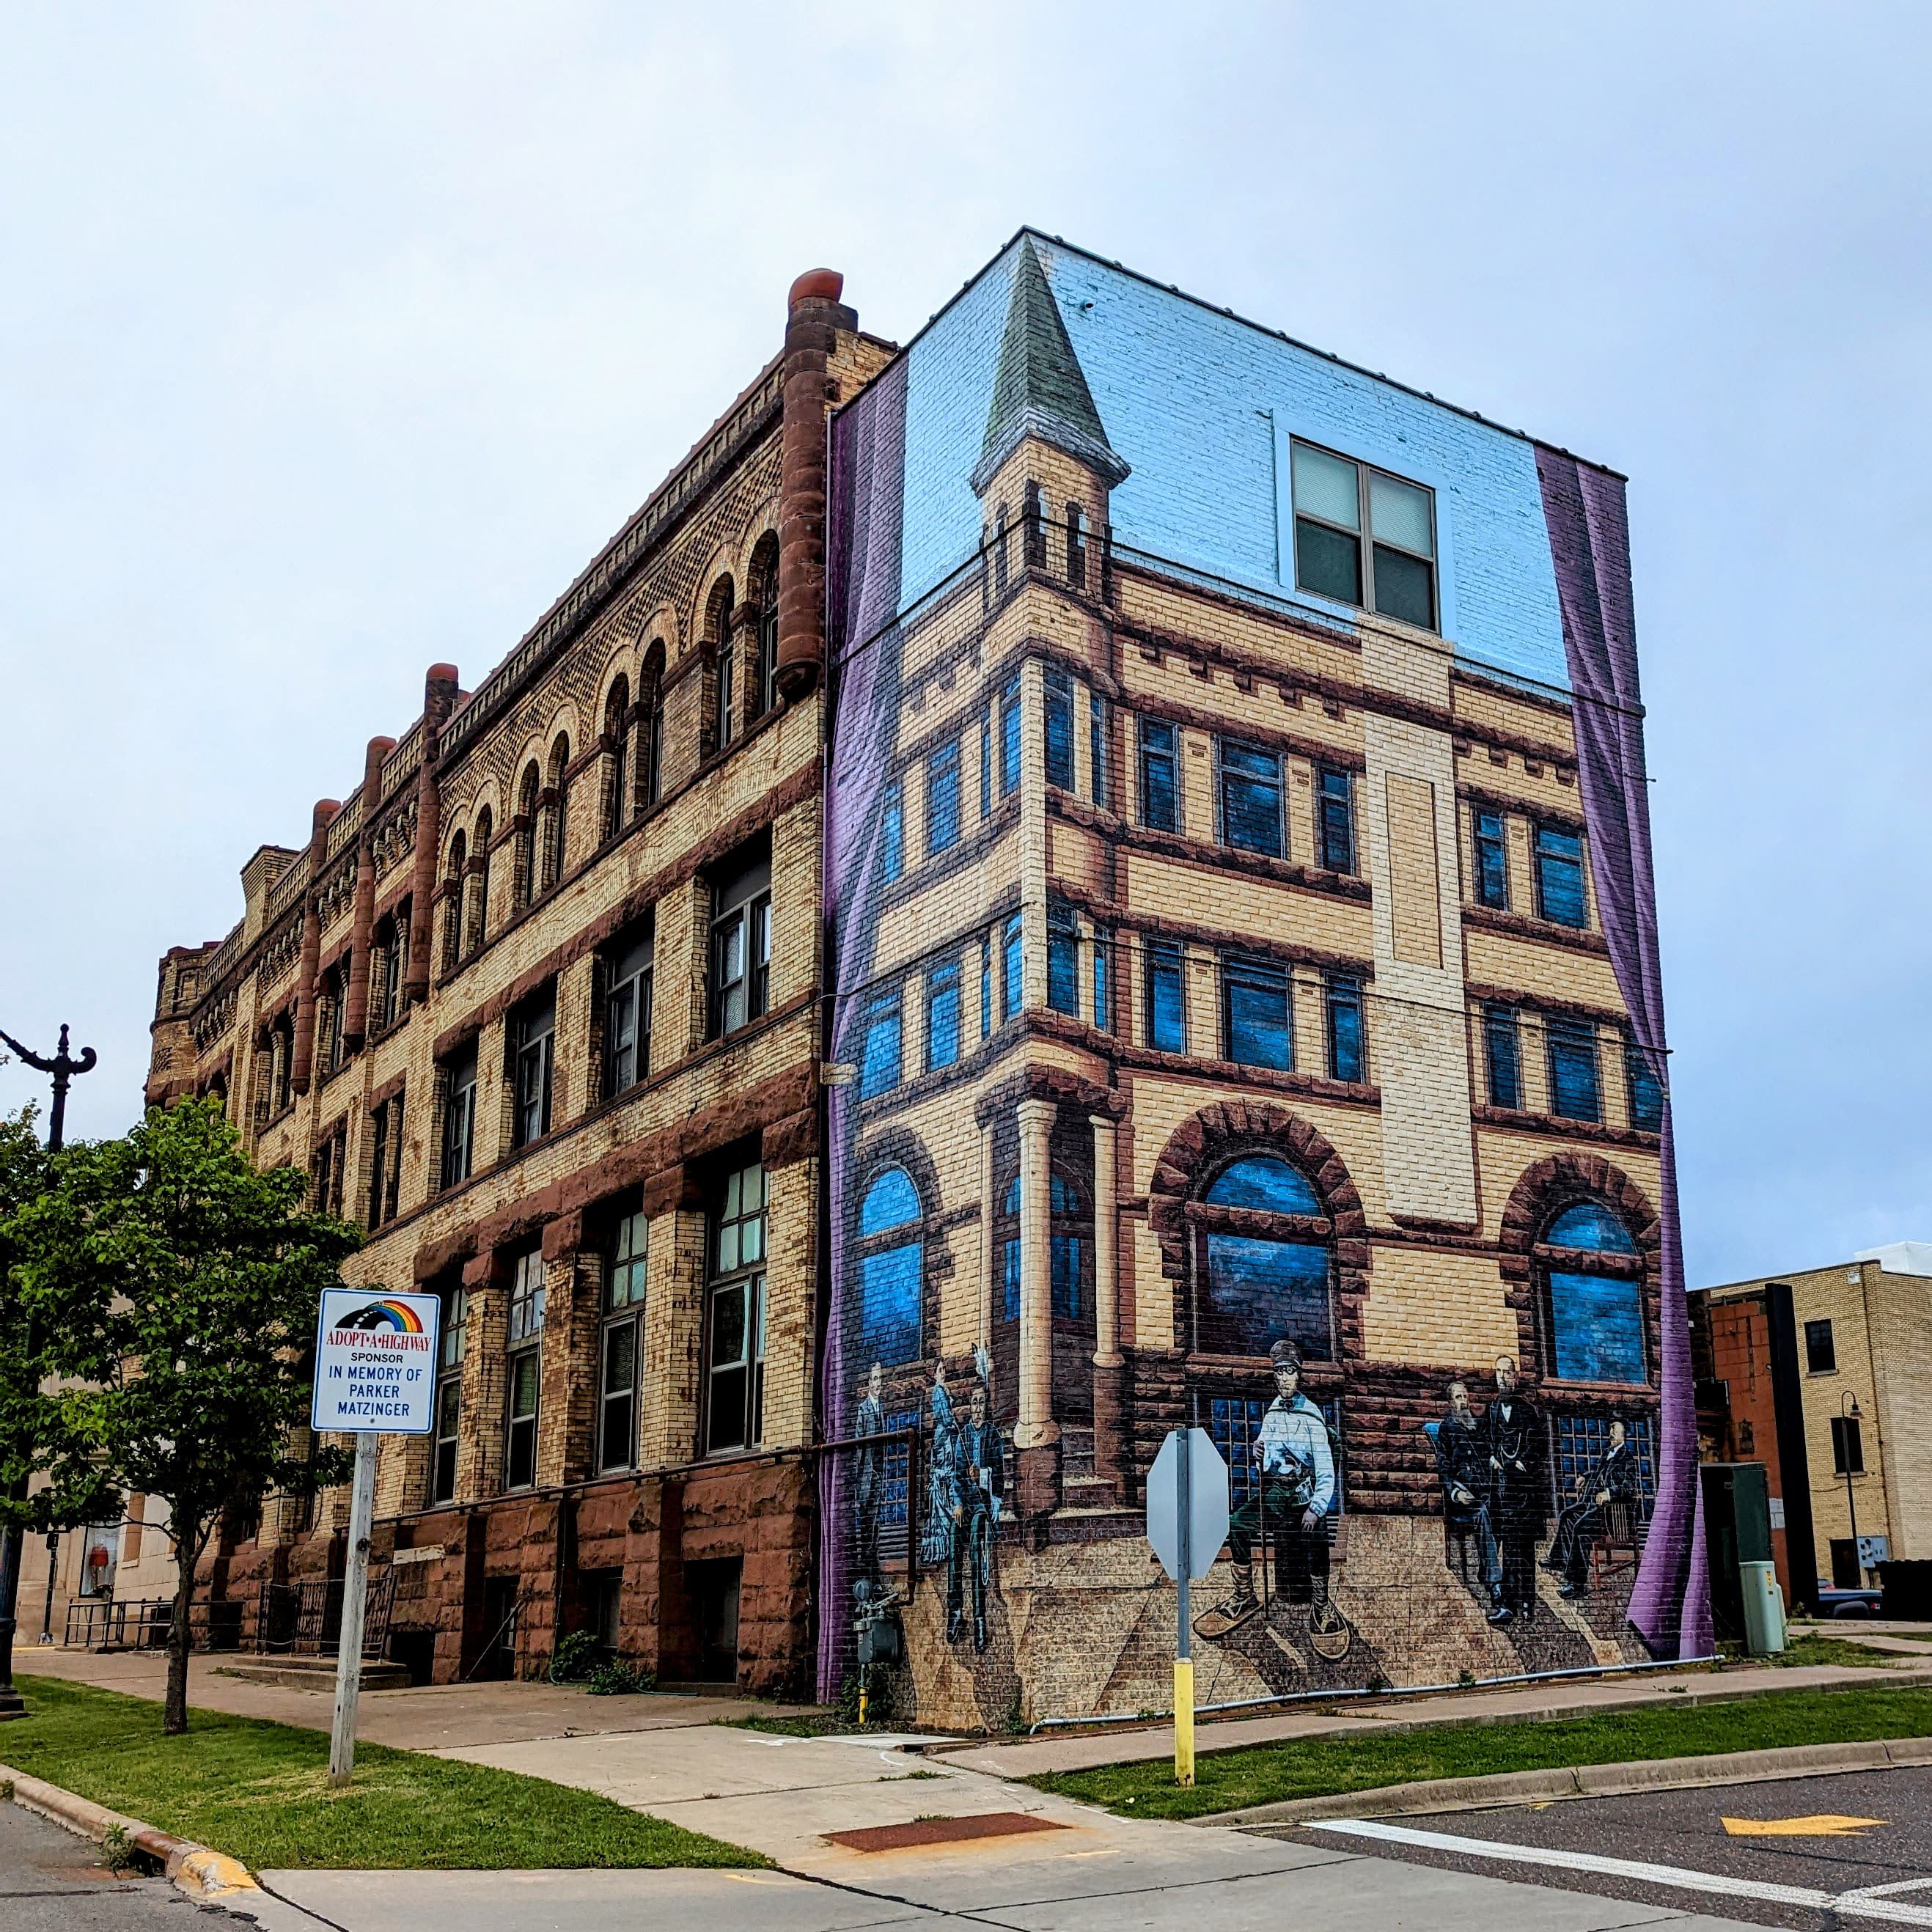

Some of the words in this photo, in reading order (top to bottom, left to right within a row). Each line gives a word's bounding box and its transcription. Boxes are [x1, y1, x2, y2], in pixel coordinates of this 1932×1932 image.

[350, 1353, 403, 1363] SPONSOR
[329, 1365, 342, 1378] IN
[348, 1367, 403, 1381] MEMORY
[406, 1369, 422, 1381] OF
[349, 1384, 400, 1398] PARKER
[337, 1401, 409, 1417] MATZINGER
